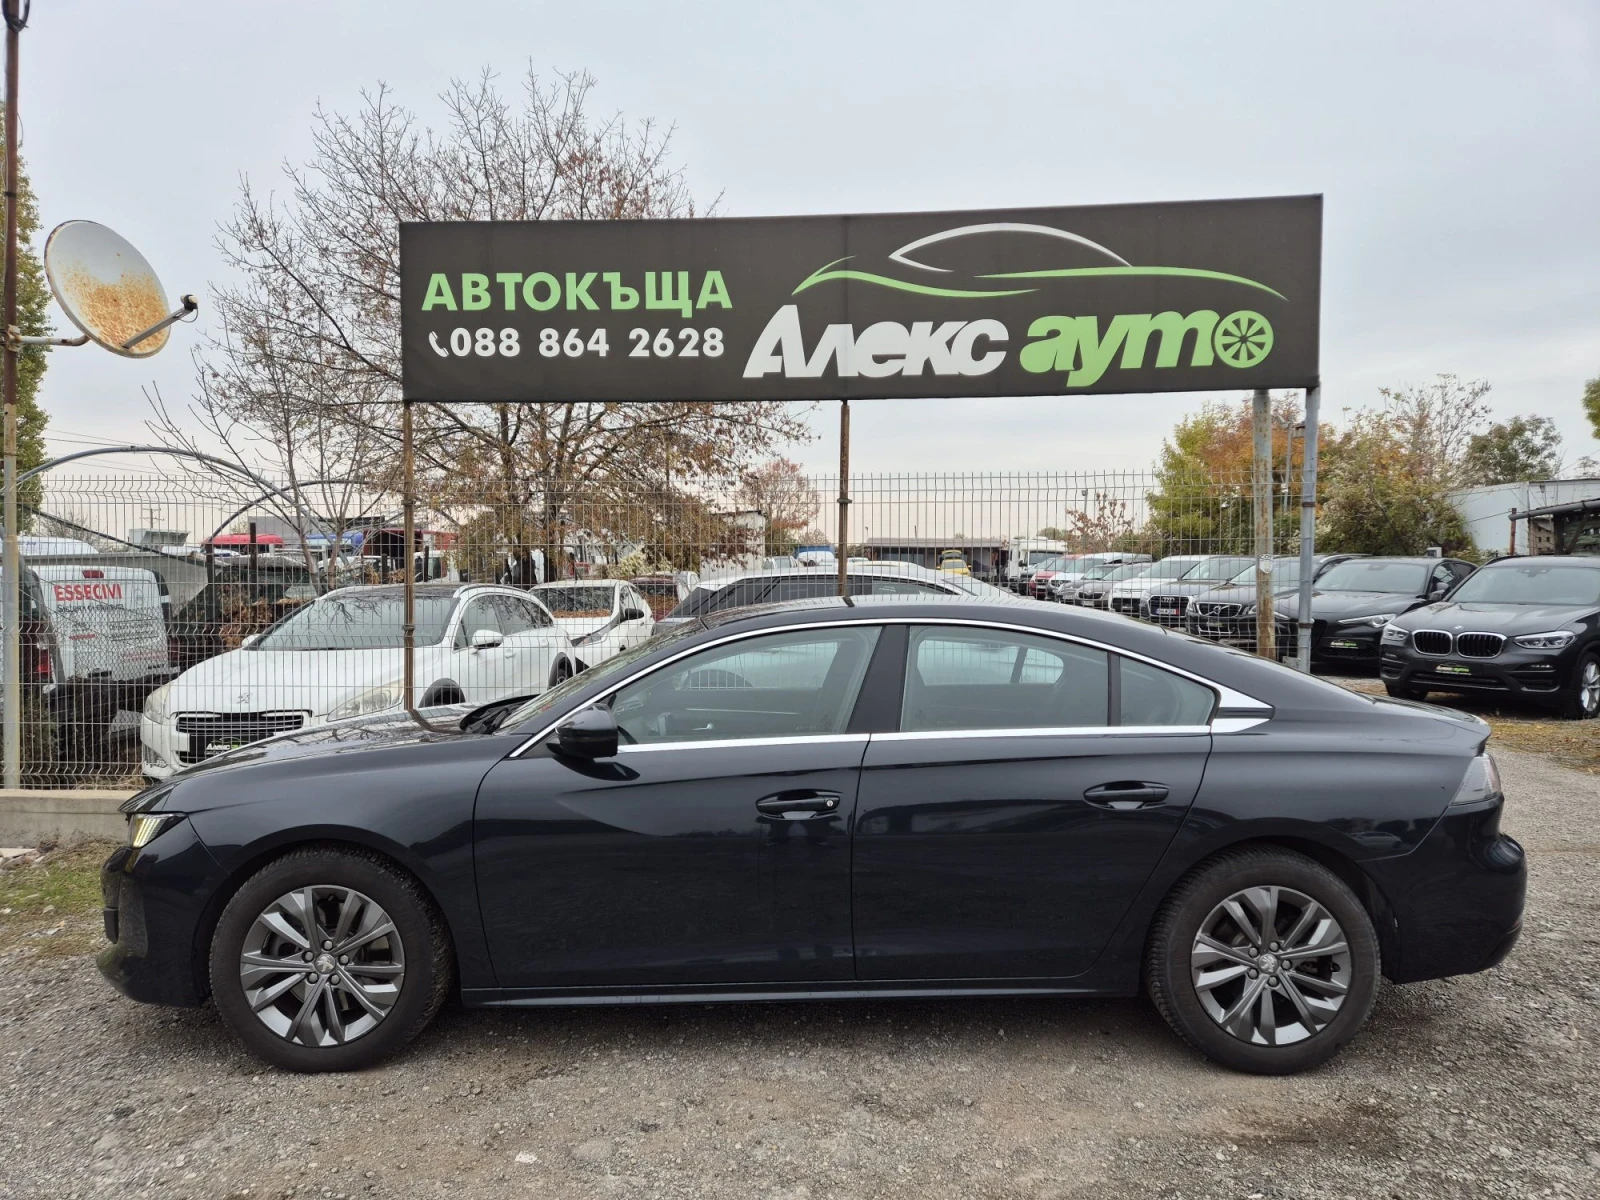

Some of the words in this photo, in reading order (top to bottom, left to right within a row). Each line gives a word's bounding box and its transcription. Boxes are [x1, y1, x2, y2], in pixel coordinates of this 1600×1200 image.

[421, 270, 733, 319] АВТОКЪЩА
[449, 327, 521, 358] 088
[538, 327, 610, 358] 864
[628, 327, 725, 358] 2628
[742, 304, 1010, 379] Алекс
